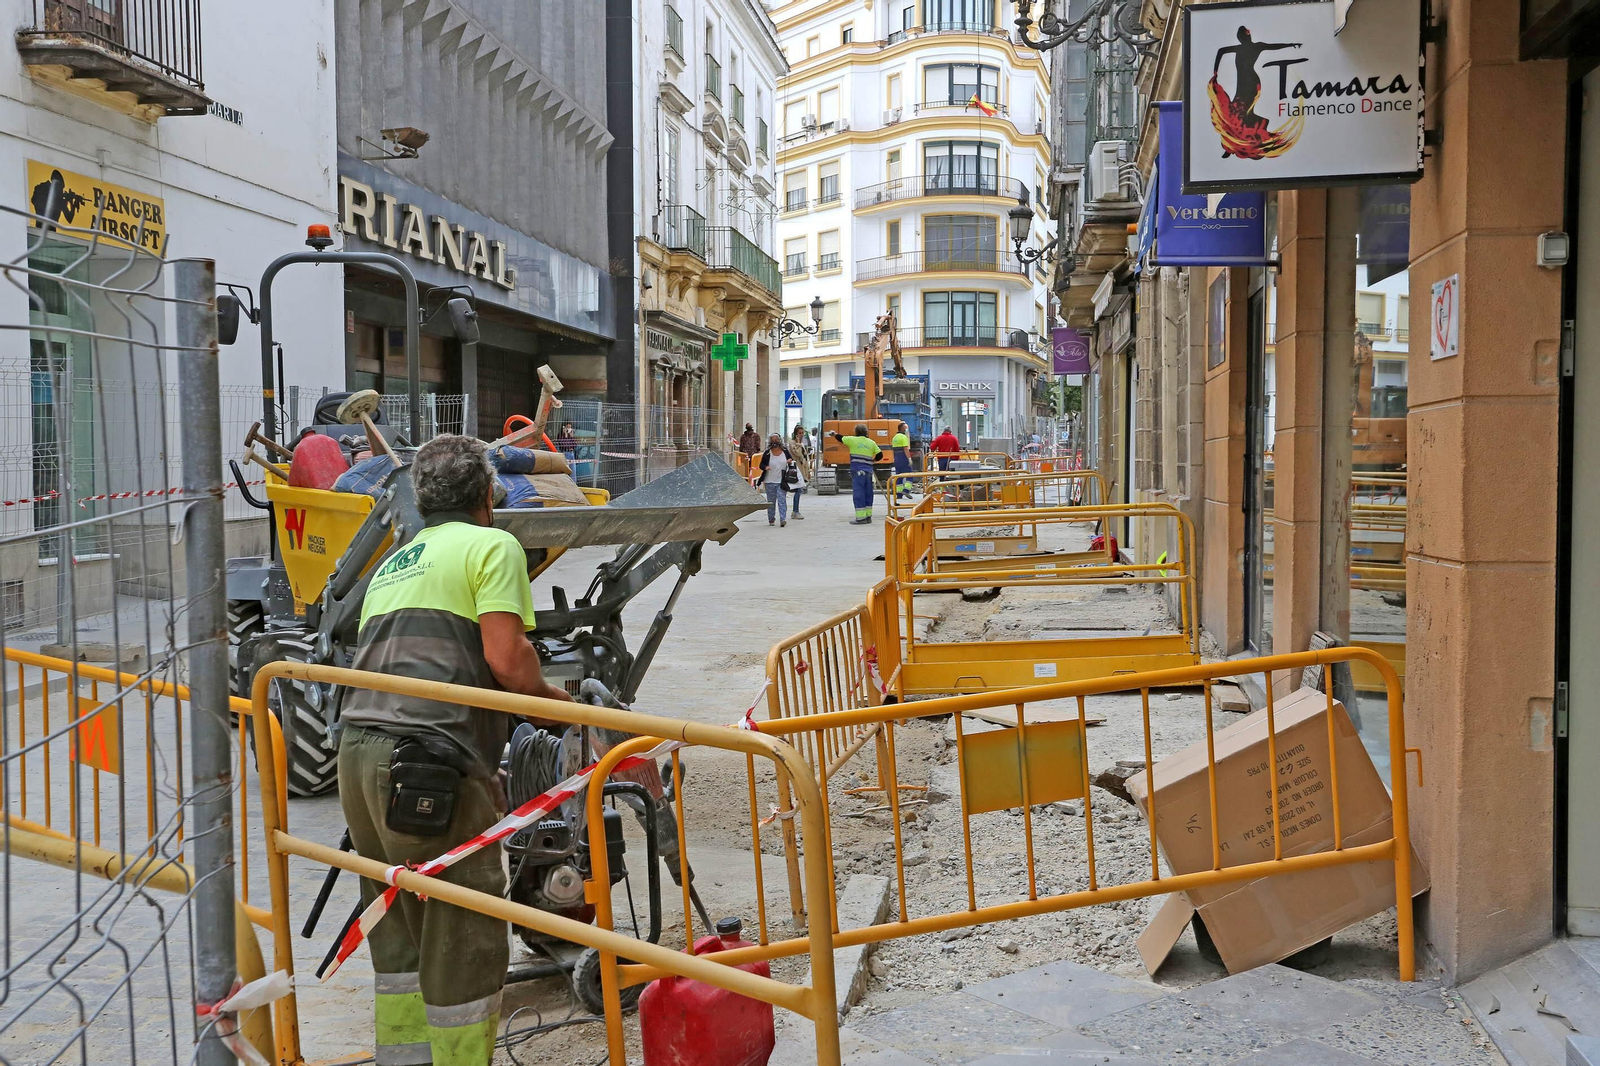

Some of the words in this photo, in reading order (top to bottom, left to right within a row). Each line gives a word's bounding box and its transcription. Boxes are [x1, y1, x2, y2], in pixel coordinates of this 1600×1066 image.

[1262, 57, 1412, 100] Tamara
[1278, 103, 1355, 117] Flamenco
[1361, 98, 1413, 113] Dance
[93, 187, 163, 225] RANGER
[1166, 205, 1258, 220] Versano
[338, 174, 516, 290] RIANAL
[939, 382, 992, 391] DENTIX
[1260, 762, 1269, 771] 10
[1296, 756, 1311, 768] SIZE
[1247, 766, 1261, 777] PRS
[1293, 769, 1318, 786] COLOUR
[1302, 781, 1324, 796] ORDER
